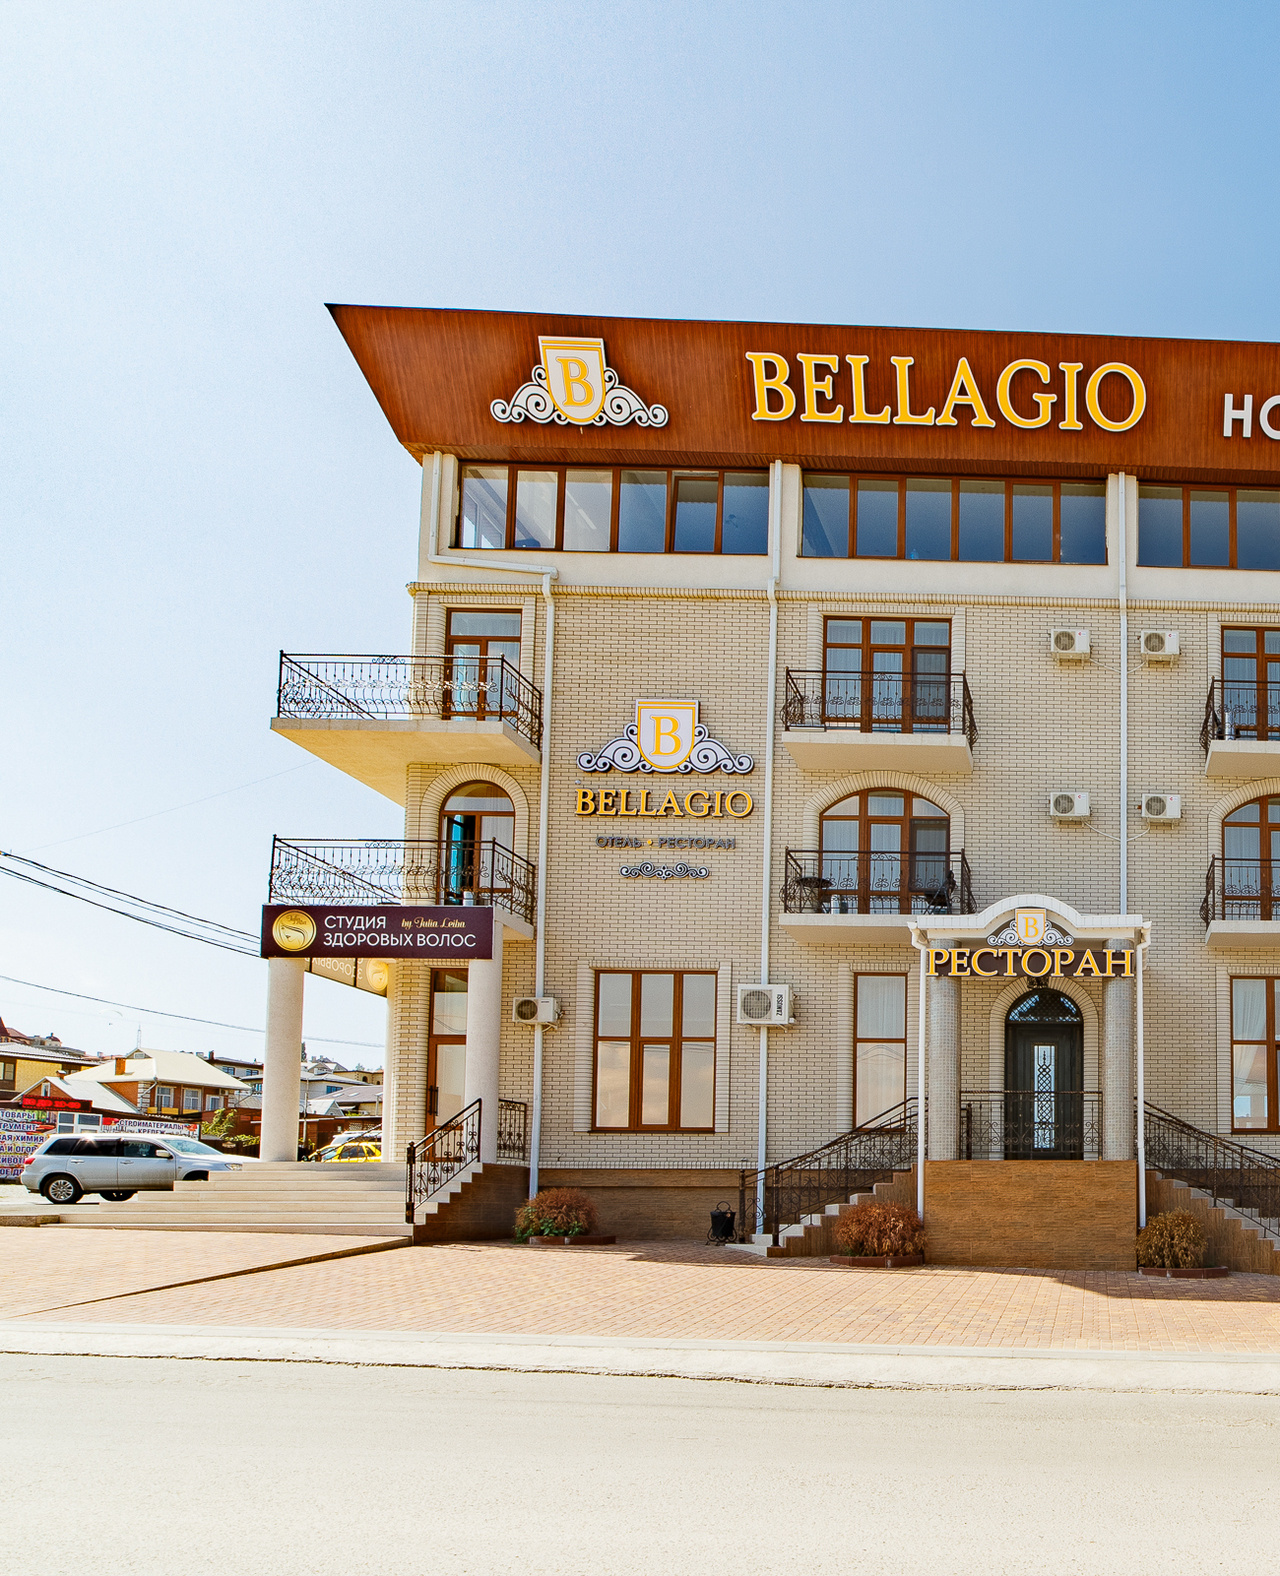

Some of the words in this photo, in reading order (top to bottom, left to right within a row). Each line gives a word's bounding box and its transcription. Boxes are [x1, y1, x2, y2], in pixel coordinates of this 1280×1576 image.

[555, 355, 595, 407] B
[745, 351, 1147, 432] BELLAGIO
[650, 715, 682, 756] B
[574, 788, 754, 818] BELLAGIO
[595, 836, 642, 848] ОТЕЛЬ
[657, 836, 736, 849] РЕСТОРАН
[324, 915, 386, 930] СТУДИЯ
[401, 918, 412, 930] by
[1023, 916, 1039, 939] B
[323, 932, 413, 947] ЗДОРОВЫХ
[417, 933, 477, 947] ВОЛОС
[926, 948, 1135, 978] РЕСТОРАН
[0, 1110, 35, 1119] ТОВАРЫ
[119, 1119, 184, 1130] СТРОЙМАТЕРИАЛЫ
[16, 1135, 44, 1143] ХИМИЯ
